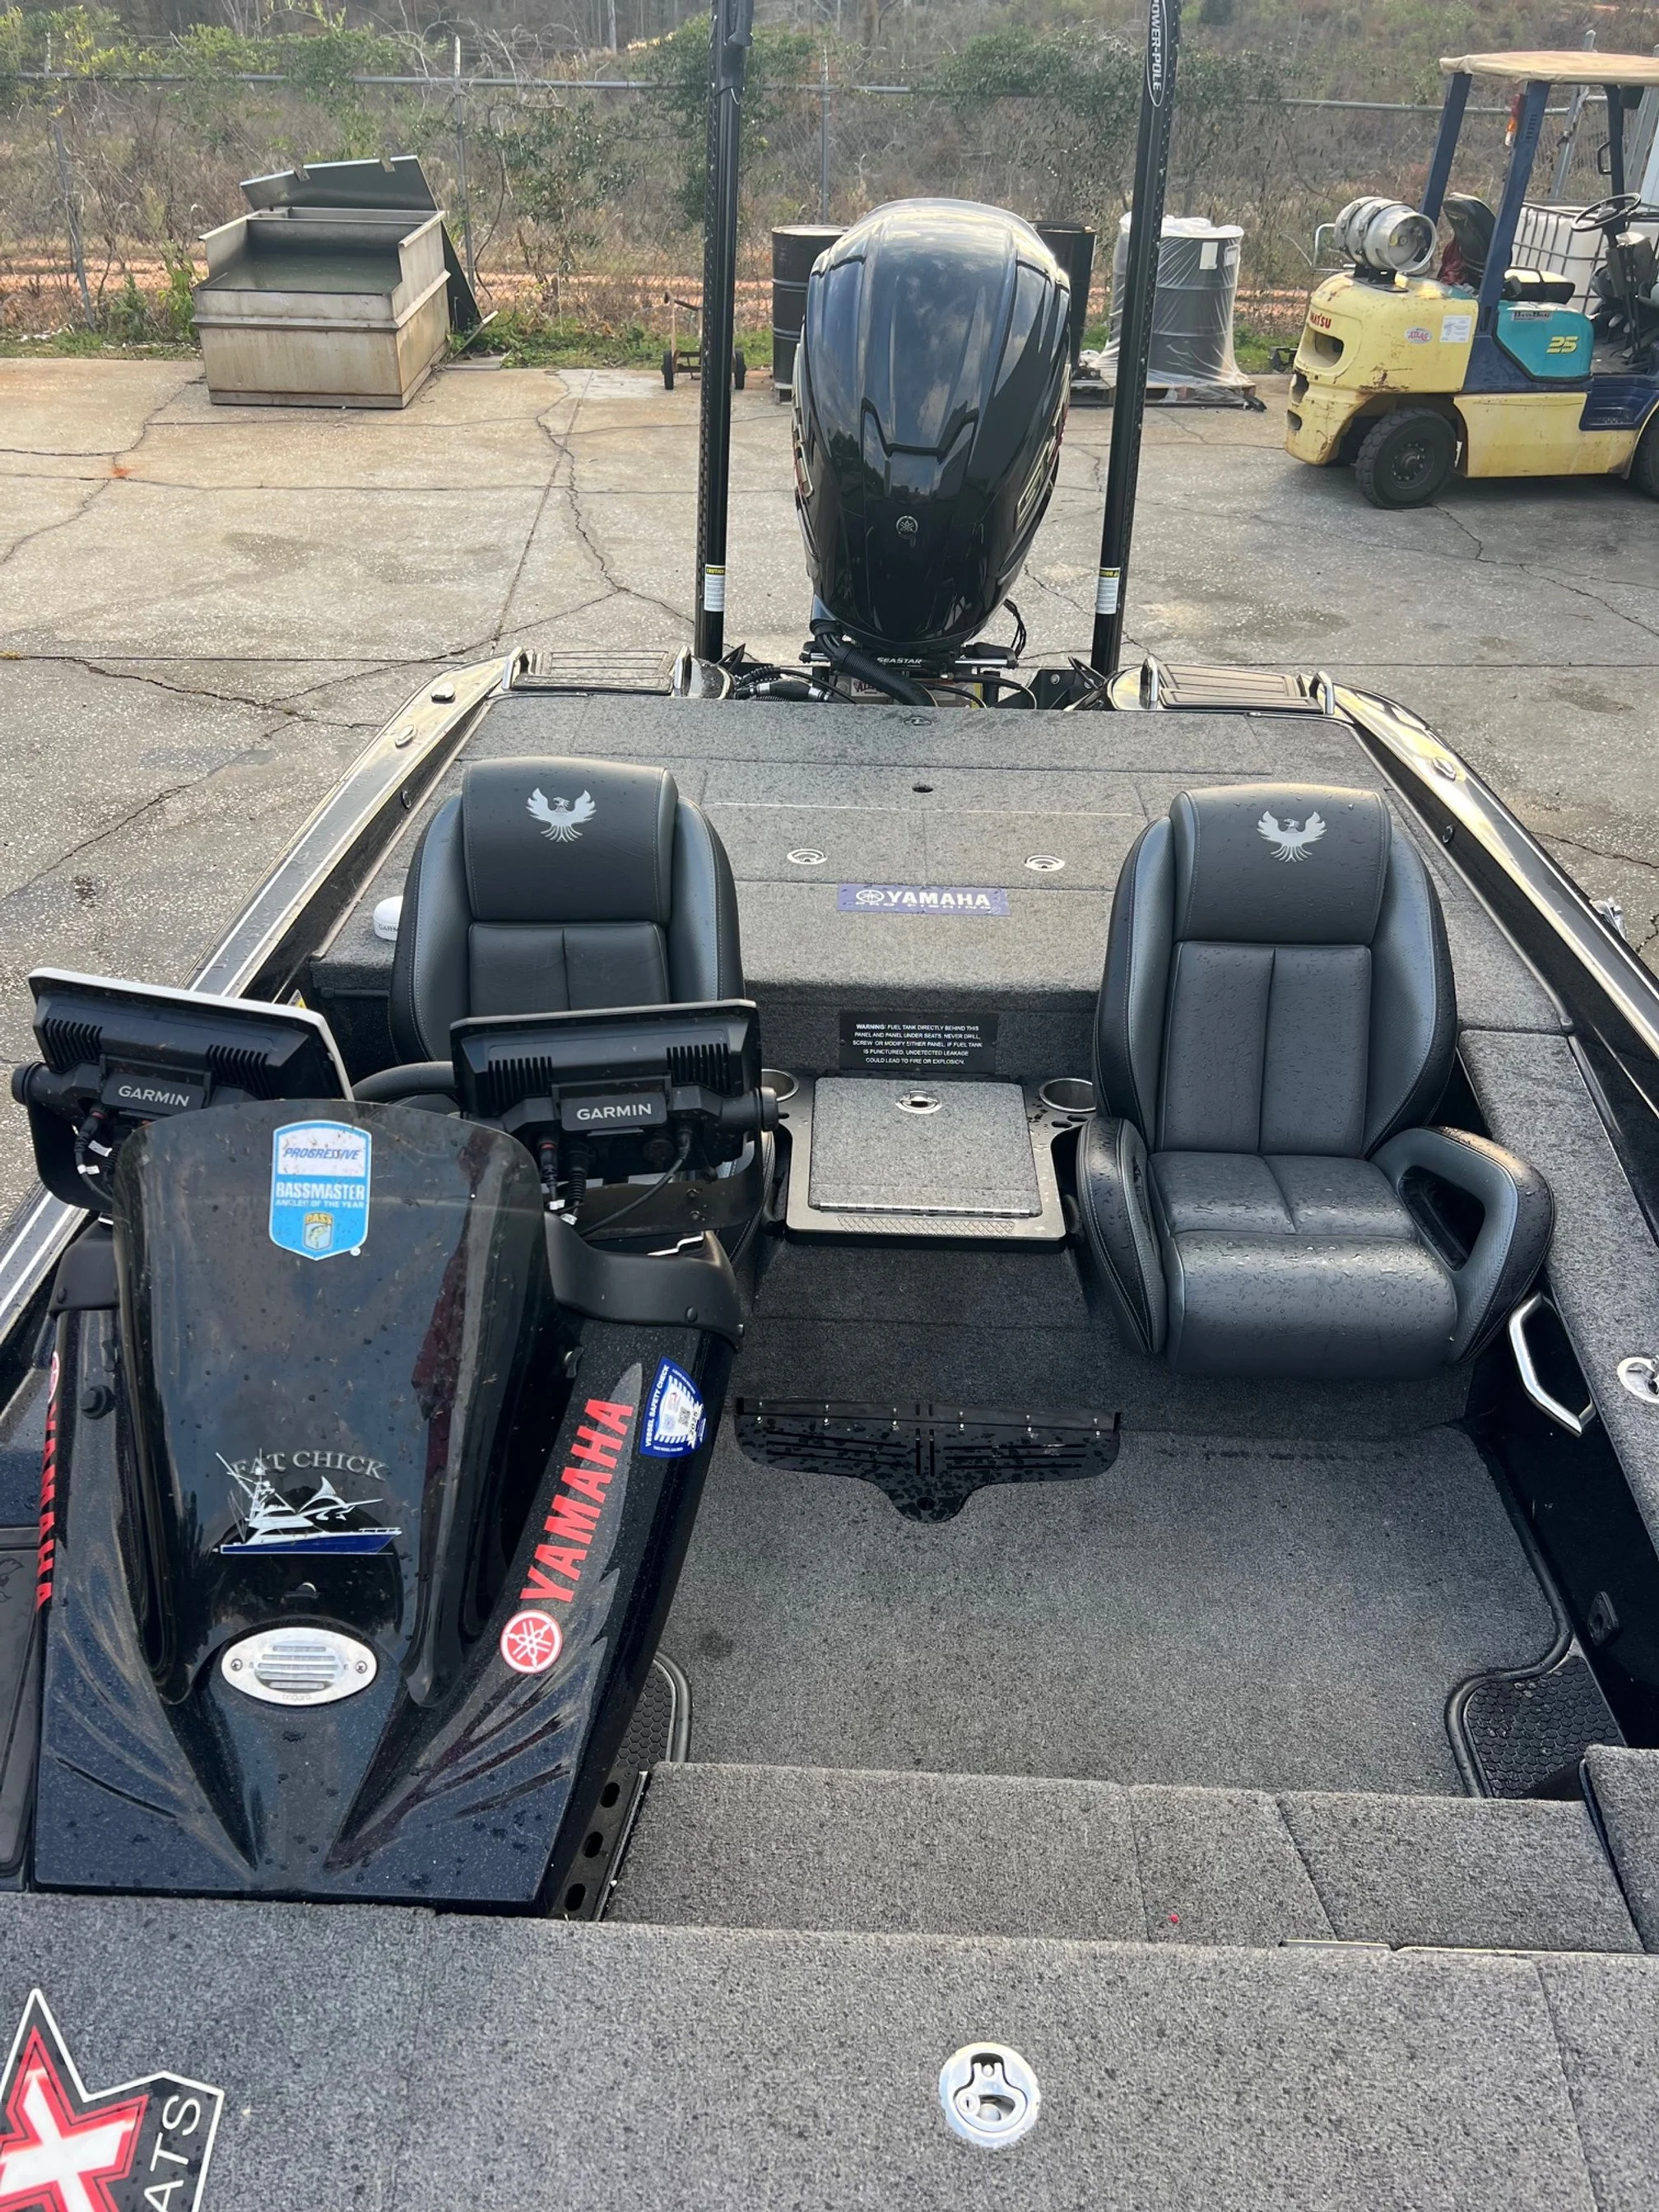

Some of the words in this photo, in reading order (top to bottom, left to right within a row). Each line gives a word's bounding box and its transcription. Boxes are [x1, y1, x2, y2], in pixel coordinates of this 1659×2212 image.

[1546, 336, 1579, 355] 25
[886, 891, 991, 906] YAMAHA
[118, 1085, 189, 1107] GARMIN
[577, 1104, 652, 1121] GARMIN
[283, 1147, 361, 1160] PROGRESSIVE
[276, 1182, 365, 1201] BASSMASTER
[276, 1199, 309, 1207] ANGLER
[311, 1200, 322, 1208] OF
[324, 1200, 340, 1208] THE
[342, 1201, 365, 1209] YEAR
[656, 1364, 670, 1391] CHECK
[648, 1387, 661, 1418] SAFETY
[645, 1417, 655, 1448] VESSEL
[231, 1452, 286, 1475] FAT
[292, 1449, 387, 1481] CHICK
[520, 1399, 634, 1603] YAMAHA
